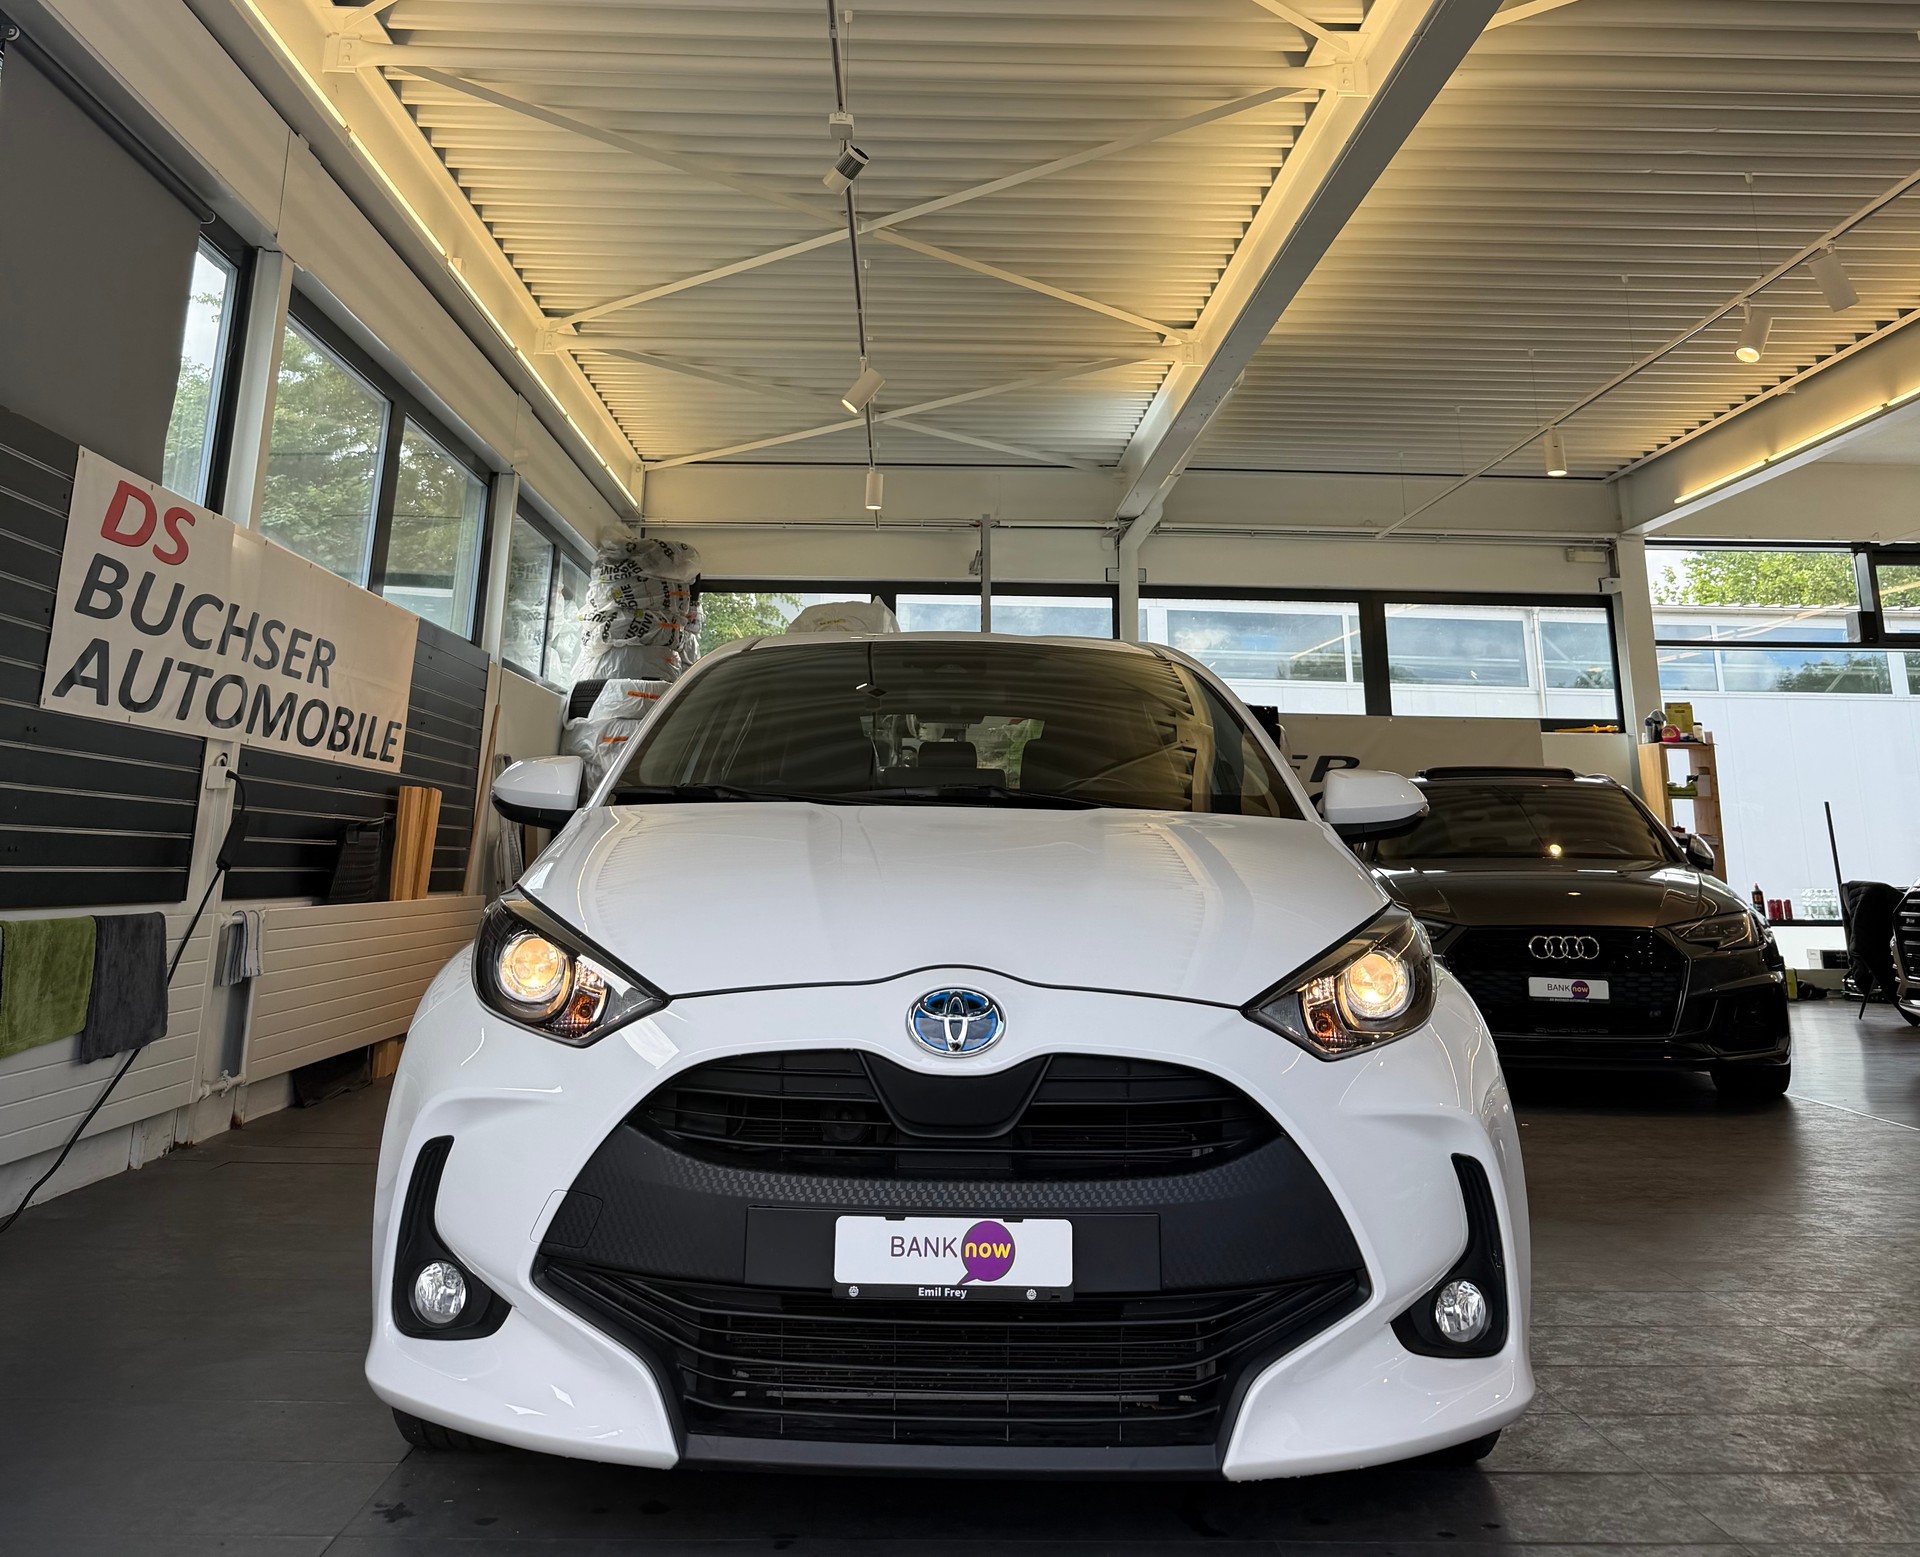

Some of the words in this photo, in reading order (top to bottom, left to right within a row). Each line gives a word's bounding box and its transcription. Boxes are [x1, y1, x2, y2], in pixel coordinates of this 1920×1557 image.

[100, 479, 196, 565] DS
[74, 552, 336, 689] BUCHSER
[51, 638, 403, 764] AUTOMOBILE
[1547, 983, 1570, 992] BANK
[890, 1236, 958, 1258] BANK
[964, 1241, 1012, 1259] now
[918, 1287, 942, 1297] Emil
[944, 1287, 967, 1299] Frey
